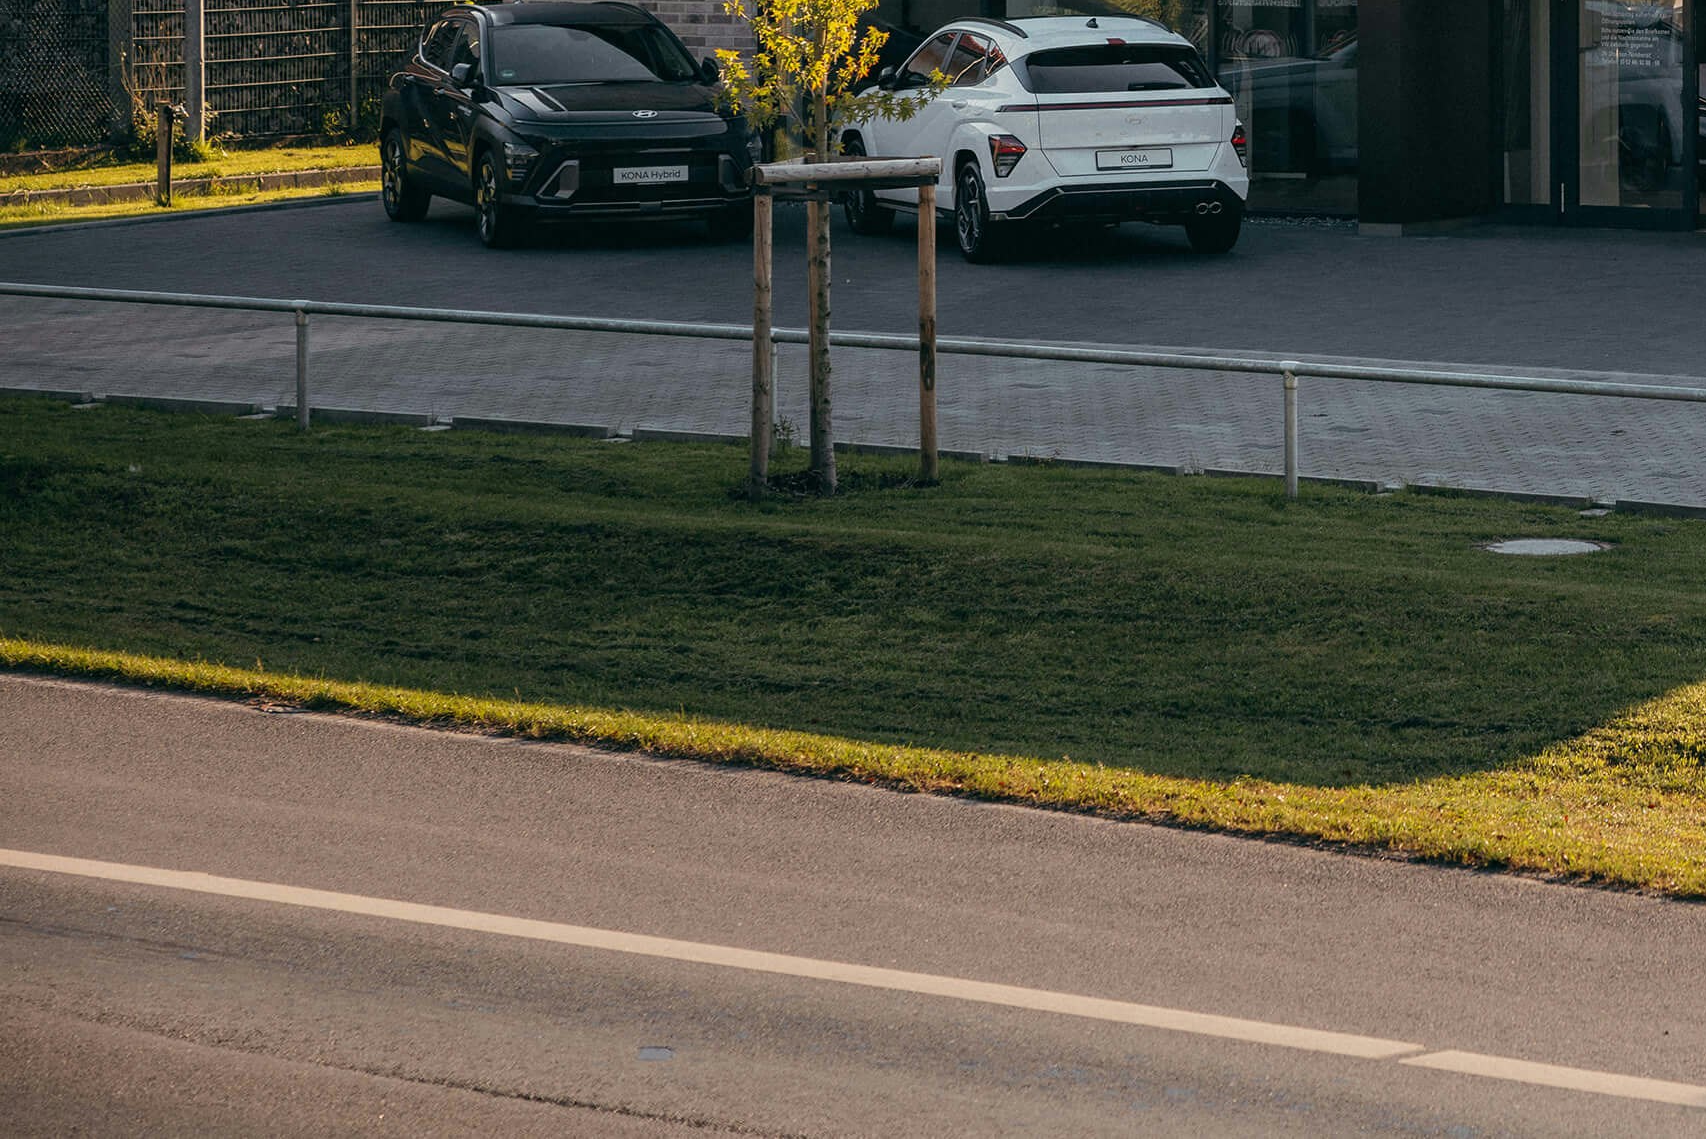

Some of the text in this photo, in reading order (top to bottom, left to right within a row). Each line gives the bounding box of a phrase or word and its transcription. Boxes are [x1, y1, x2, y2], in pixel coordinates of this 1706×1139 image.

[1120, 154, 1149, 164] KONA
[621, 169, 681, 180] KONA Hybrid
